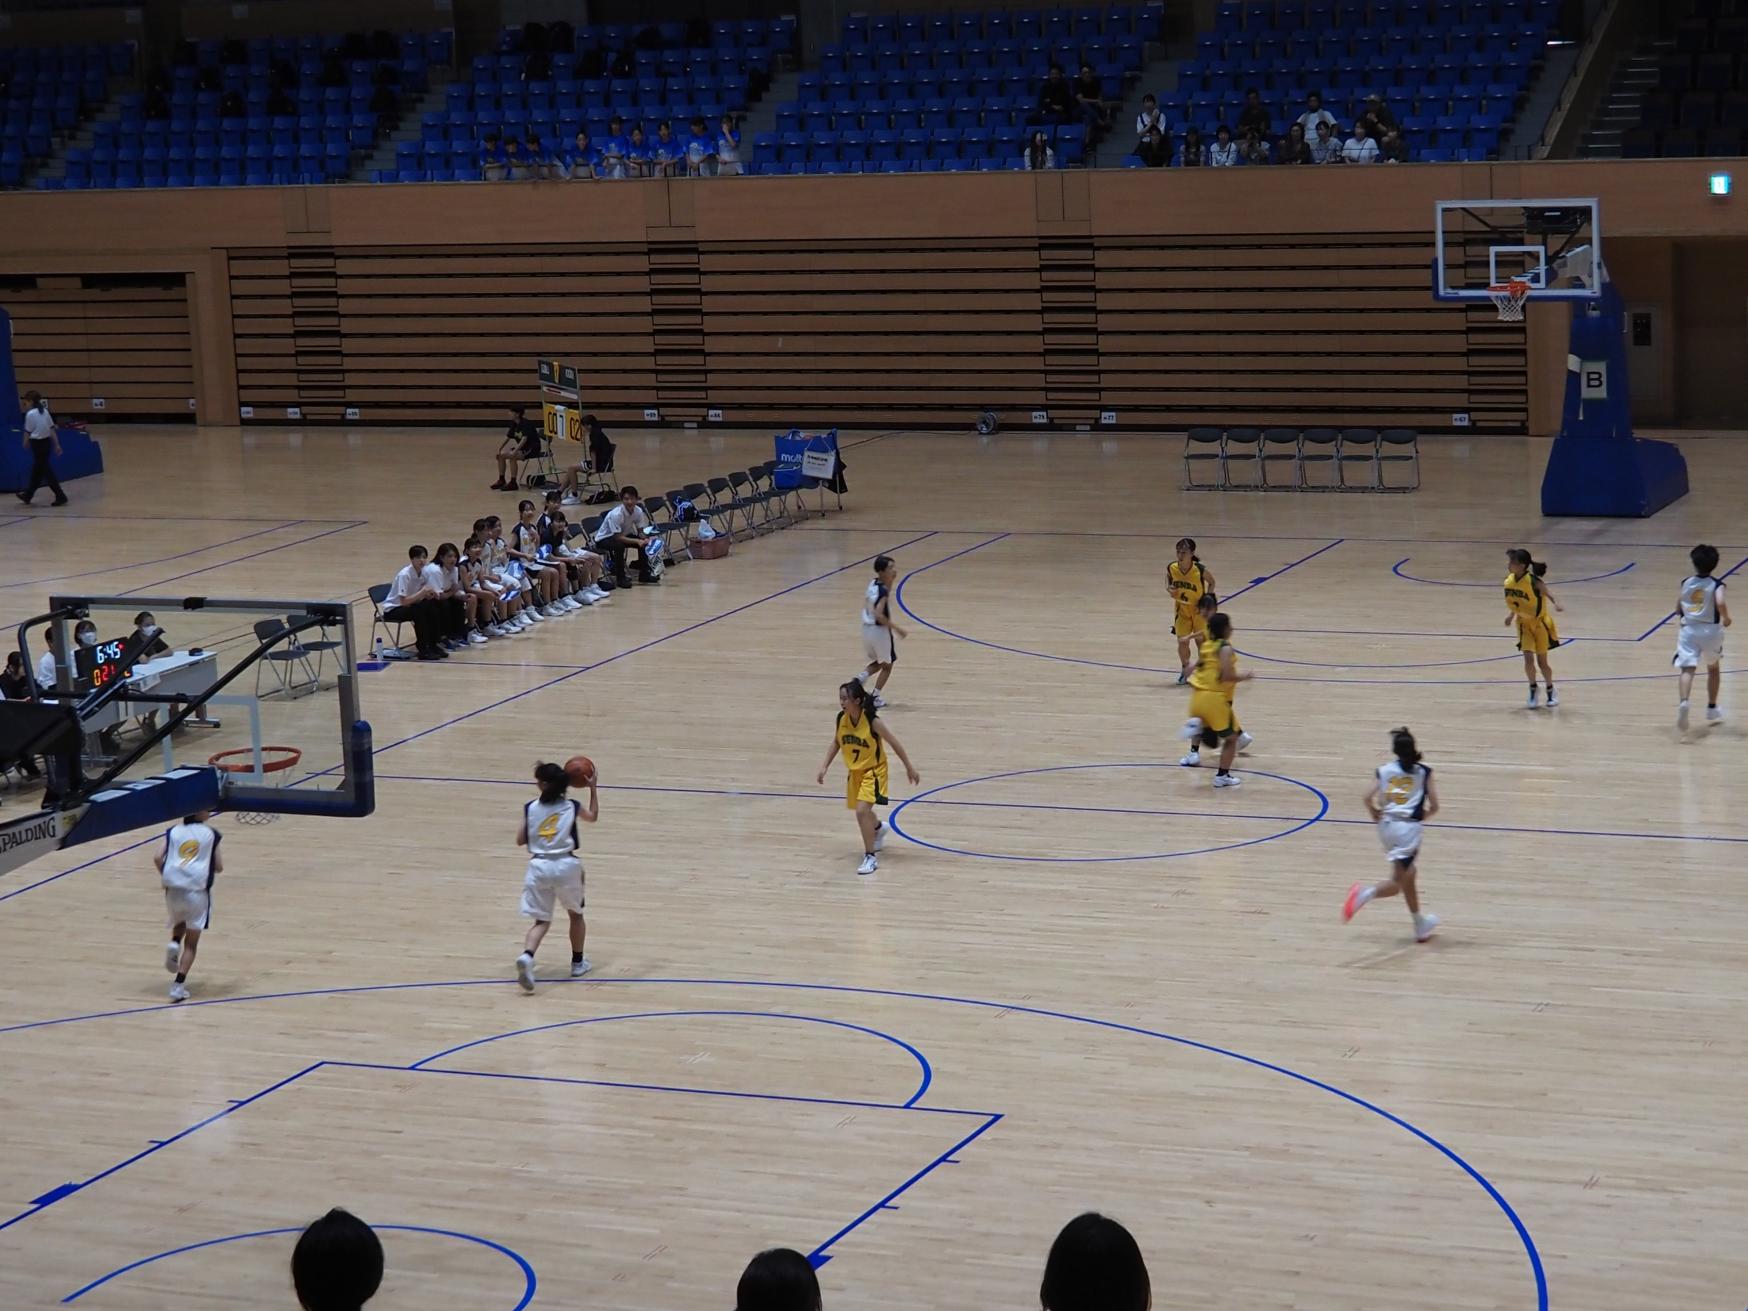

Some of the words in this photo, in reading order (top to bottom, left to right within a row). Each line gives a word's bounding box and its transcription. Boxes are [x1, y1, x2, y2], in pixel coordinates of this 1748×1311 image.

[1586, 371, 1603, 388] B
[96, 641, 121, 664] 6:45
[852, 749, 861, 763] 7
[0, 816, 56, 853] PALDING
[537, 812, 561, 844] 4
